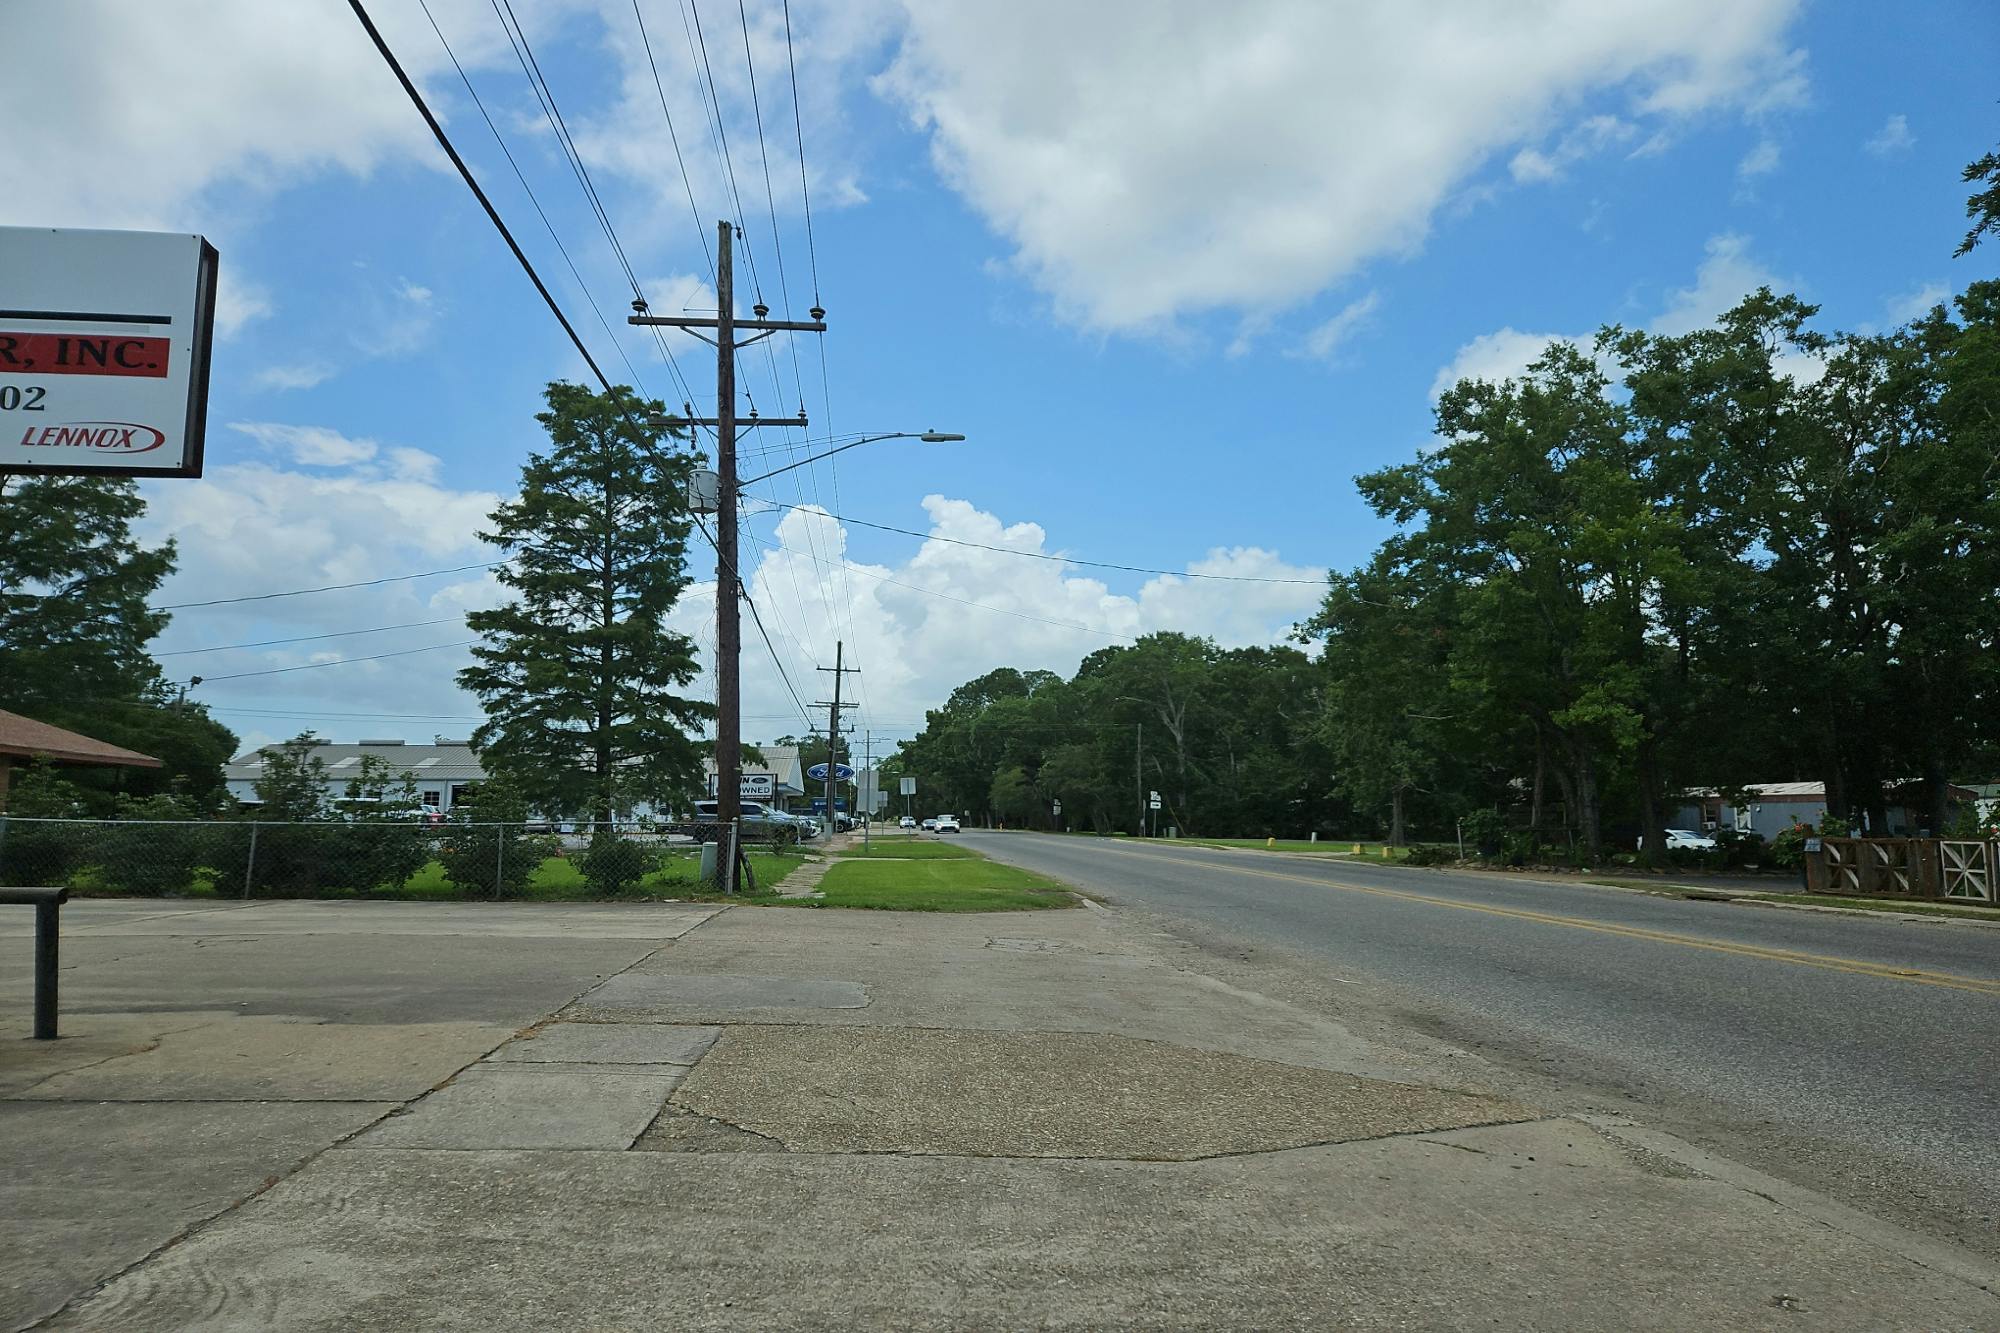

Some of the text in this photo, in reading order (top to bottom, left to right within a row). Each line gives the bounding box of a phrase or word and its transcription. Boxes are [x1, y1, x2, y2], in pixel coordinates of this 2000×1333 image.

[54, 338, 158, 369] INC.
[0, 385, 46, 411] 02
[20, 426, 137, 448] LENNOX
